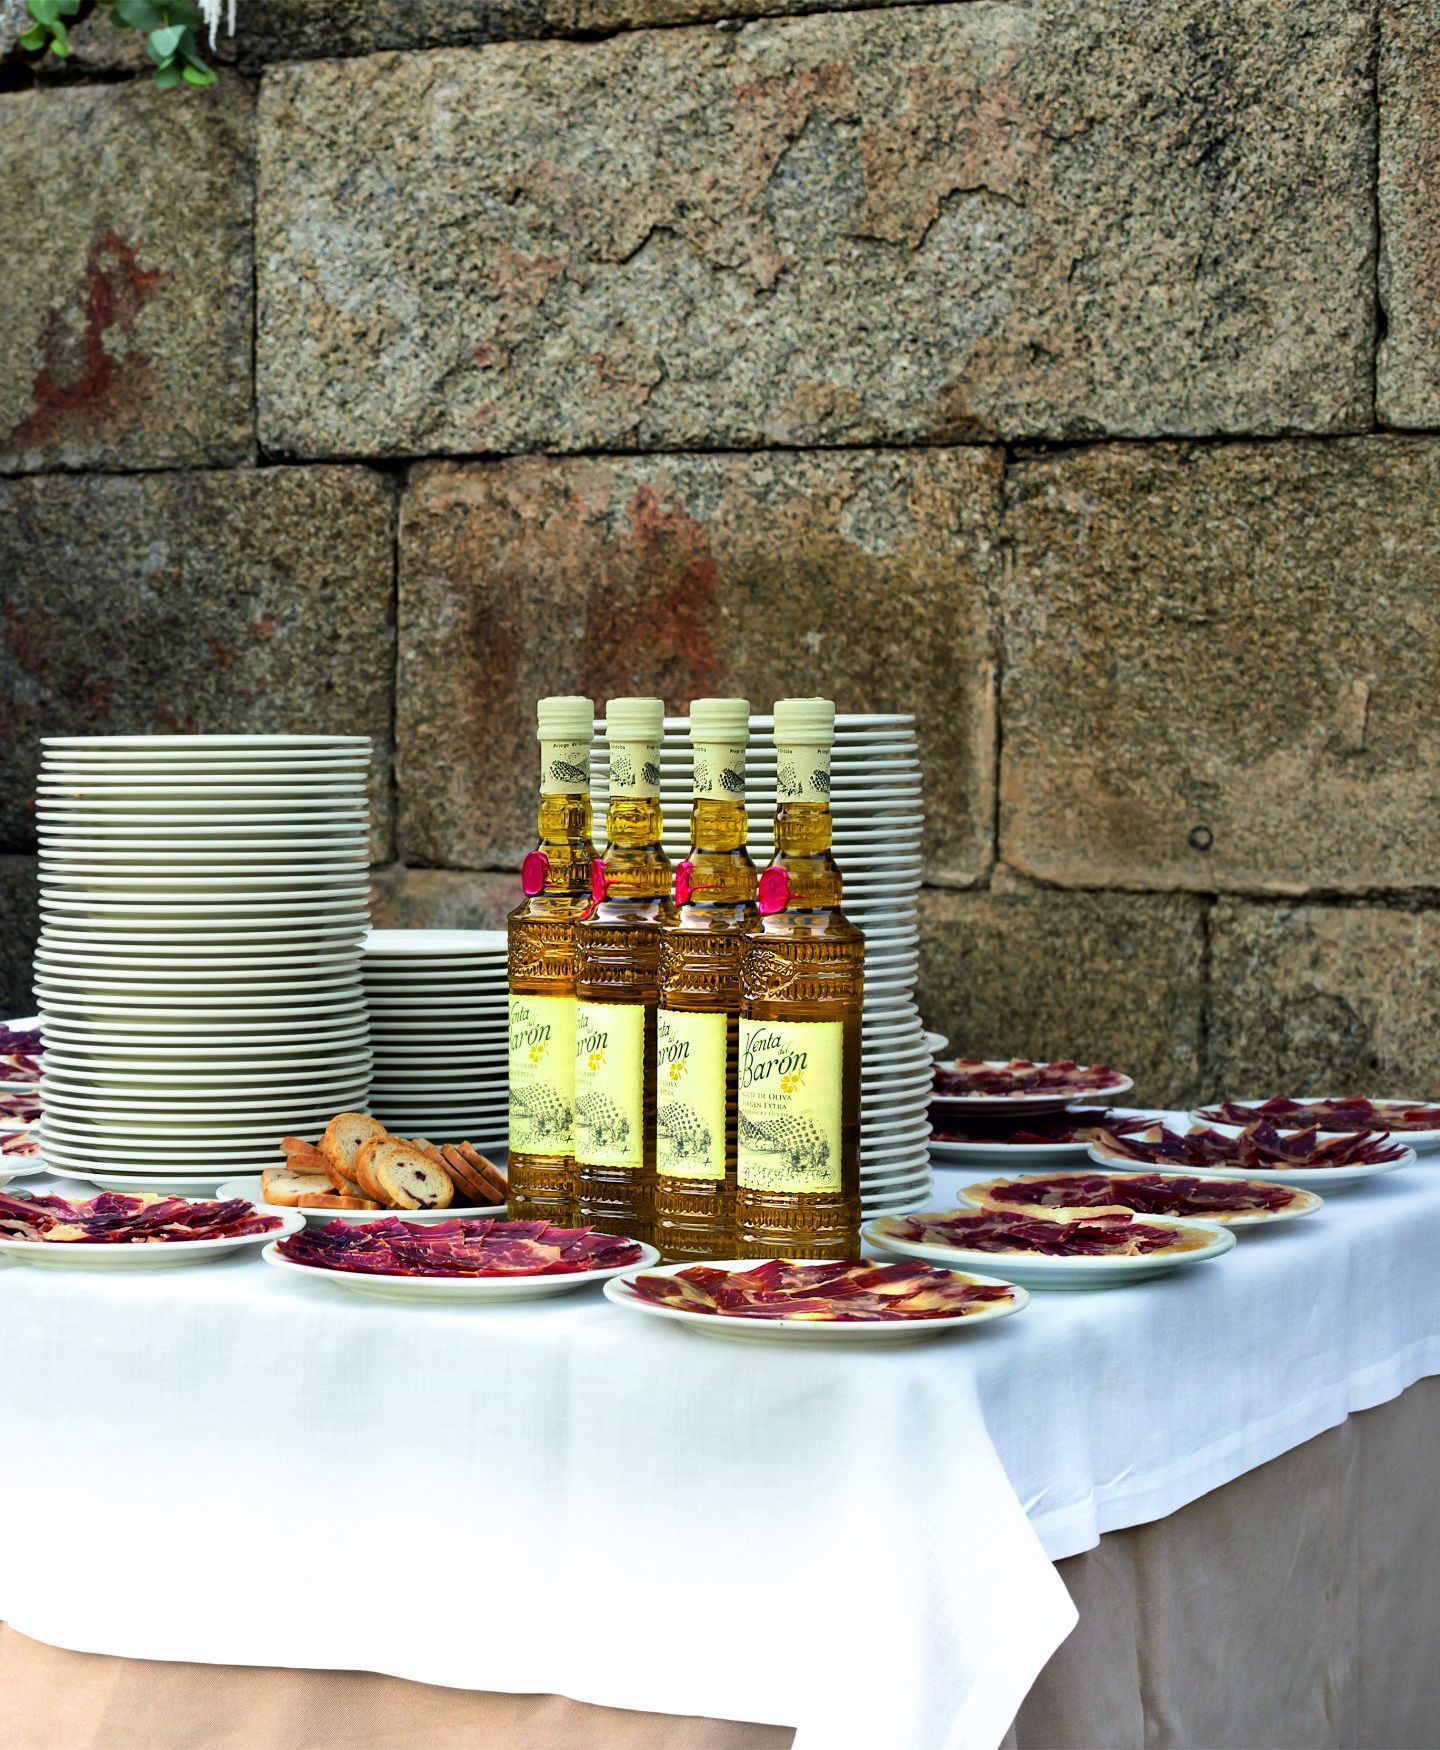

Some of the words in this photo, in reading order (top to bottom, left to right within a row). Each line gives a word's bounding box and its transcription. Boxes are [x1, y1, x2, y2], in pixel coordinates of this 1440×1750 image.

[510, 1023, 552, 1051] arón
[576, 1030, 608, 1058] arón
[745, 1027, 782, 1053] Venta
[657, 1040, 690, 1067] arón
[740, 1051, 808, 1088] Barón
[763, 1102, 788, 1110] EXTRA
[768, 1093, 792, 1101] OLIVA
